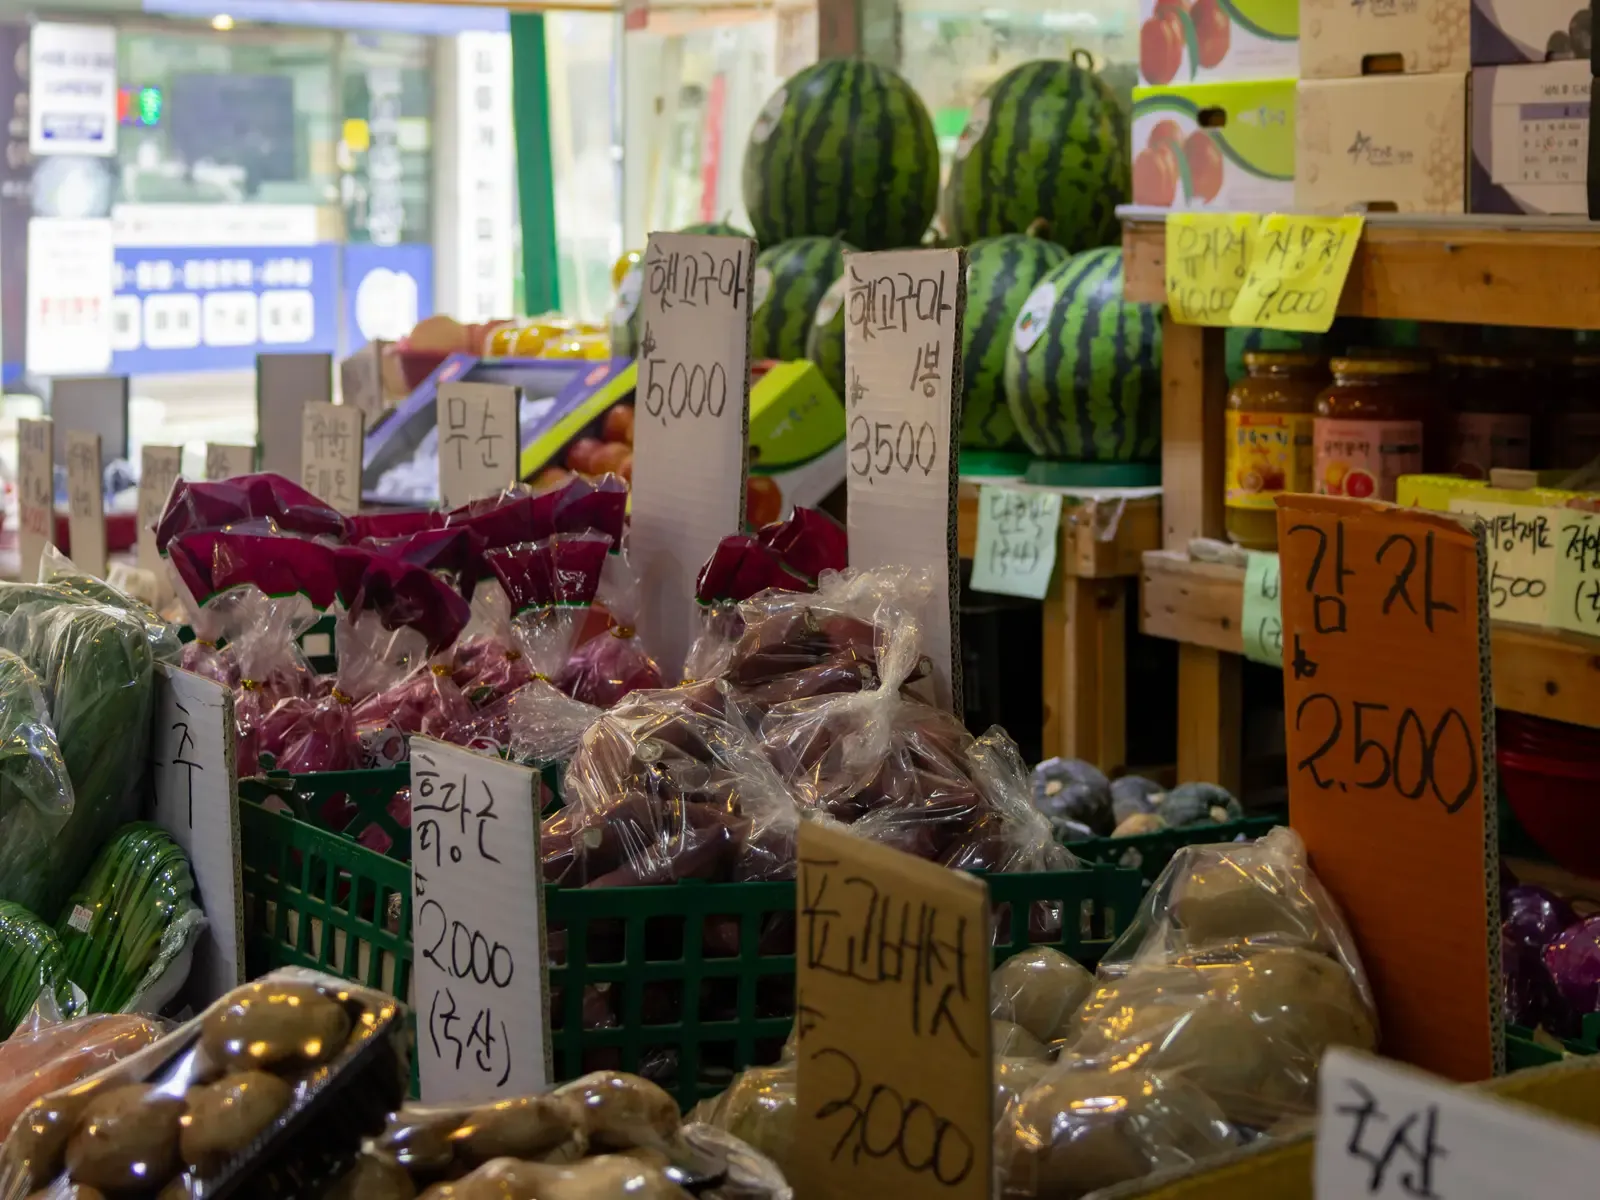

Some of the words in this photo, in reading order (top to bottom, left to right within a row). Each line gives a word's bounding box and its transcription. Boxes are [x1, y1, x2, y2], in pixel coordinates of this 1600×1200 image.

[647, 244, 746, 313] 햇고구마
[850, 266, 952, 342] 햇고구마
[645, 359, 726, 426] 5,000
[445, 397, 503, 470] 무순
[850, 415, 936, 485] 3,500
[1288, 521, 1458, 633] 감자
[1296, 692, 1477, 814] 2,500
[418, 900, 513, 987] 2,000
[429, 989, 511, 1087] (국산)
[811, 1048, 974, 1186] 3,000
